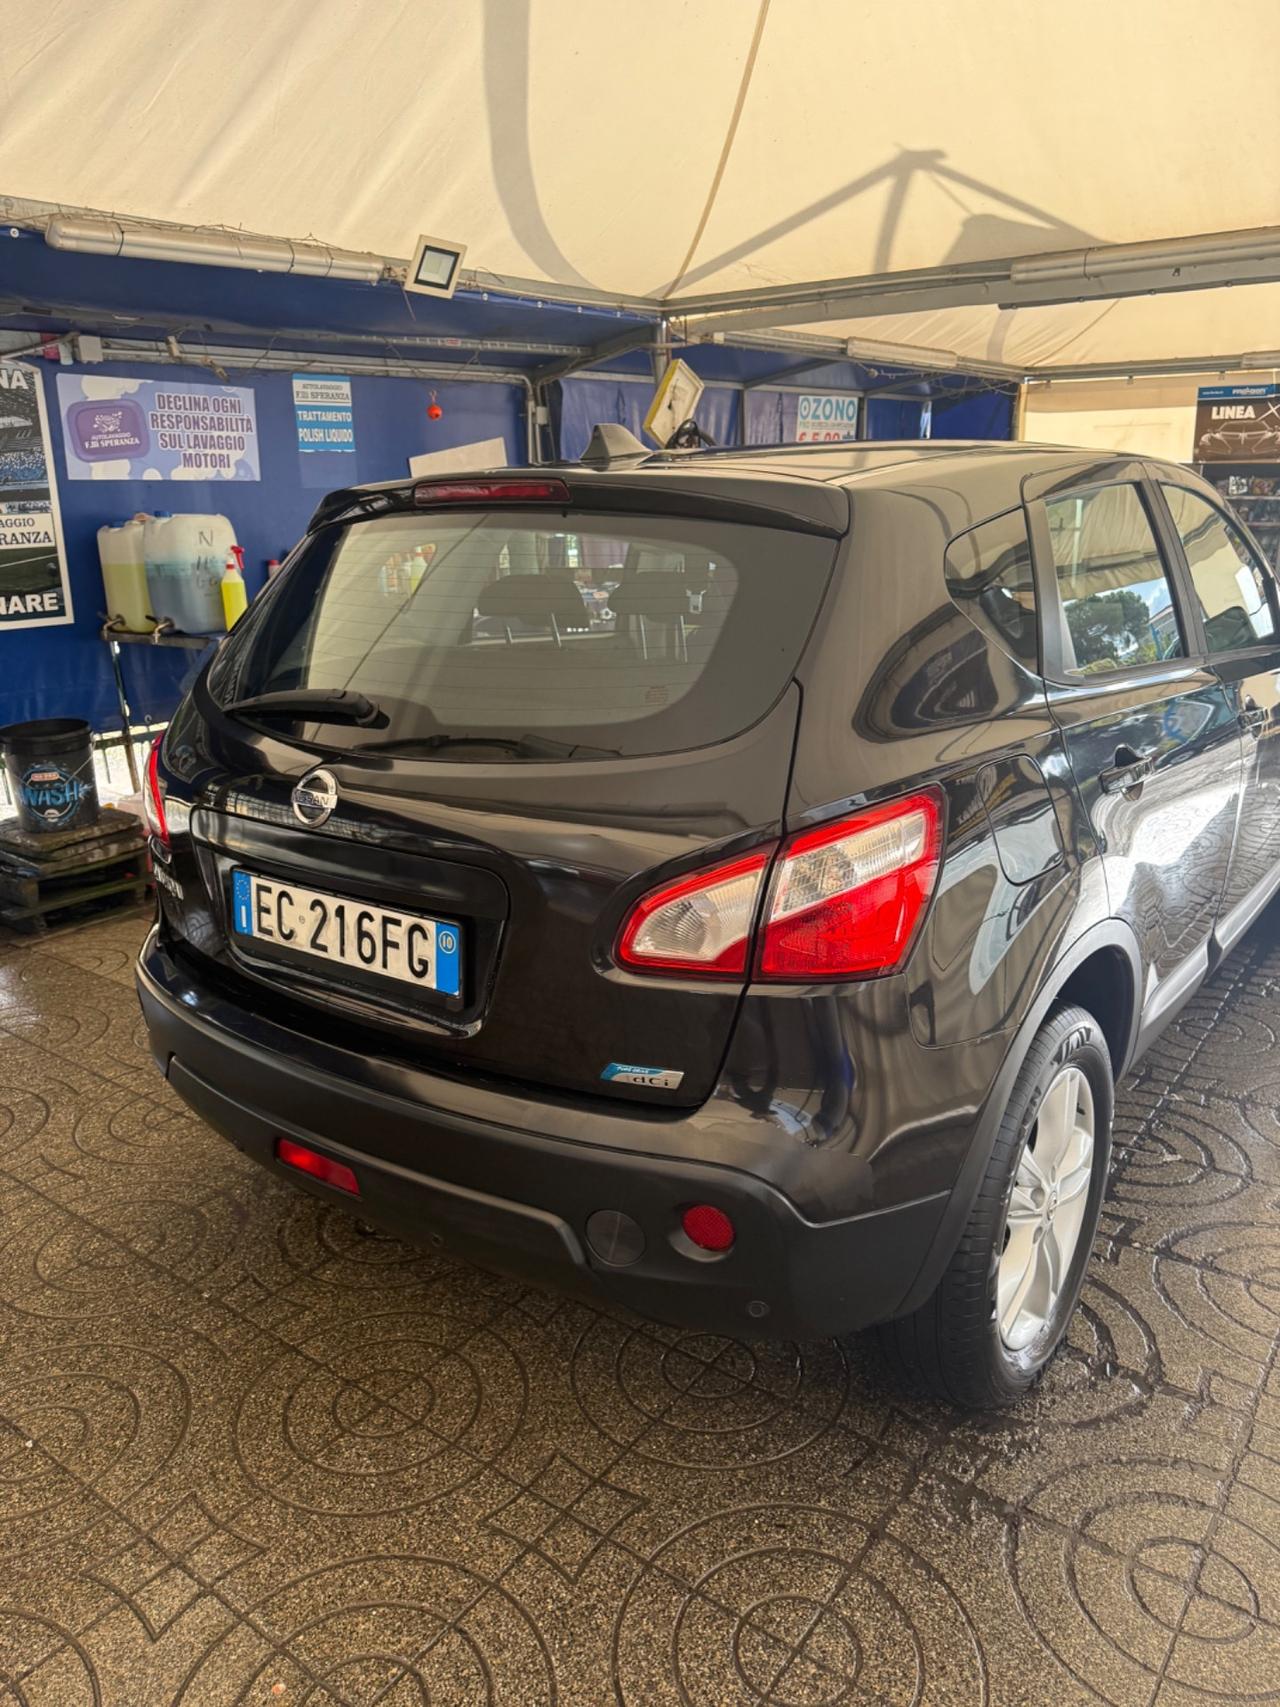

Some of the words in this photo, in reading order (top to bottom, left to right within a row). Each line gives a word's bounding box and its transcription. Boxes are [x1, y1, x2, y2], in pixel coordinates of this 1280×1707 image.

[157, 394, 209, 412] DECLINA
[212, 398, 242, 414] OGNI
[800, 397, 856, 421] OZONO
[1211, 405, 1256, 420] LINEA
[150, 412, 253, 433] RESPONSABILITÀ
[297, 411, 352, 422] TRATTAMENTO
[100, 438, 140, 447] SPERANZA
[159, 432, 185, 450] SUL
[186, 434, 245, 451] LAVAGGIO
[299, 428, 325, 442] POLISH
[326, 428, 352, 443] LIQUIDO
[182, 452, 231, 469] MOTORI
[22, 781, 79, 805] WASH
[255, 883, 295, 941] EC
[309, 898, 429, 979] 216FG
